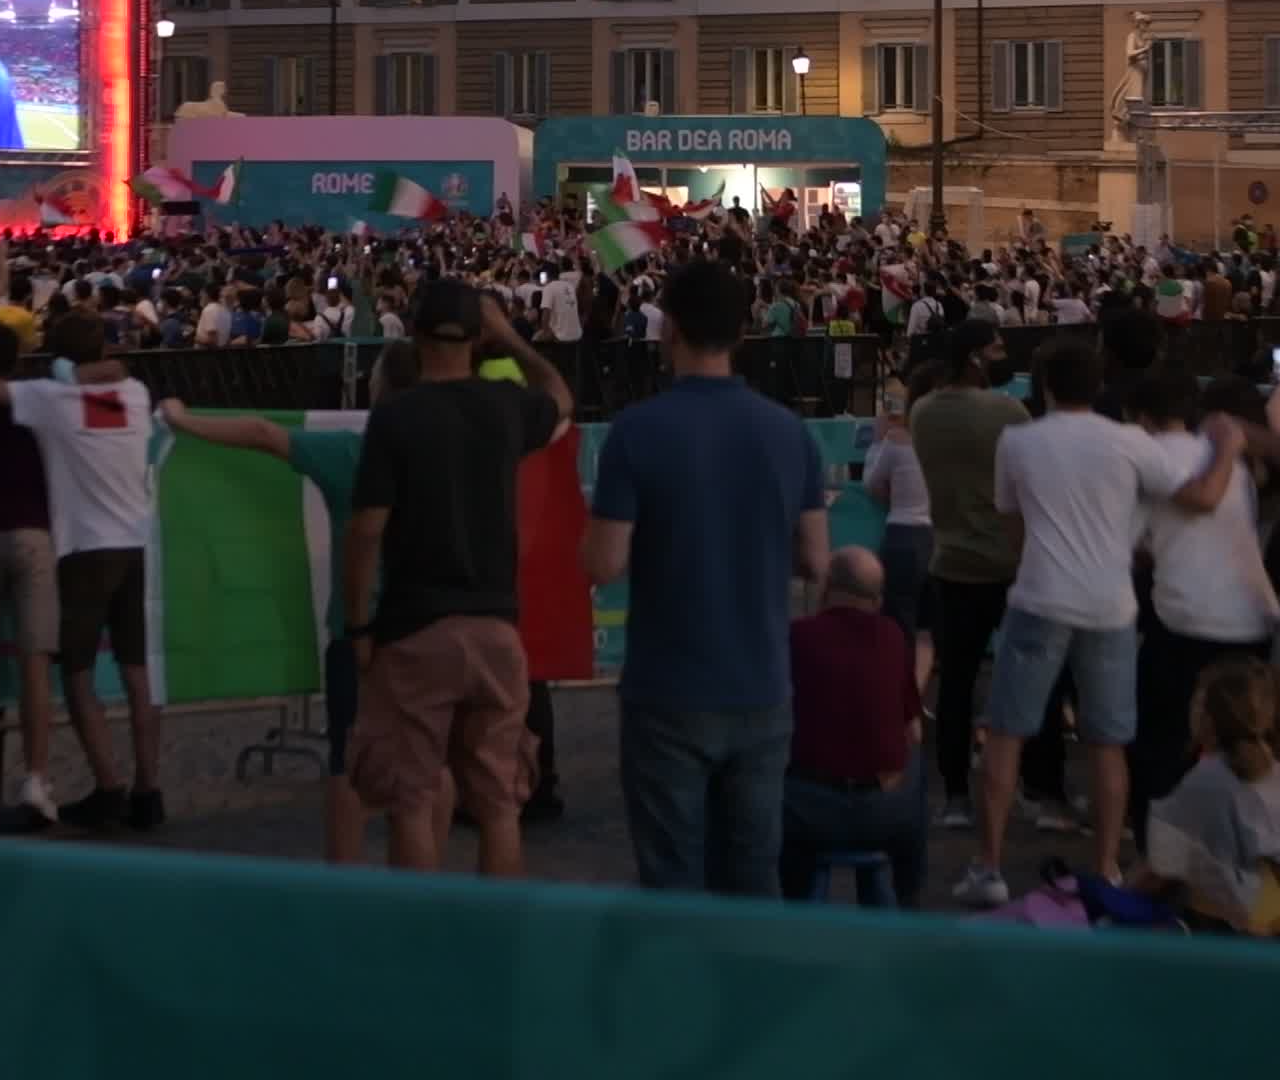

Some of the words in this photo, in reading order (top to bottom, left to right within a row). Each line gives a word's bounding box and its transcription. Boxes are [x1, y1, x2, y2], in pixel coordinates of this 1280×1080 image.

[626, 129, 672, 152] BAR
[677, 129, 723, 151] DEA
[728, 128, 793, 151] ROMA
[311, 172, 376, 195] ROME
